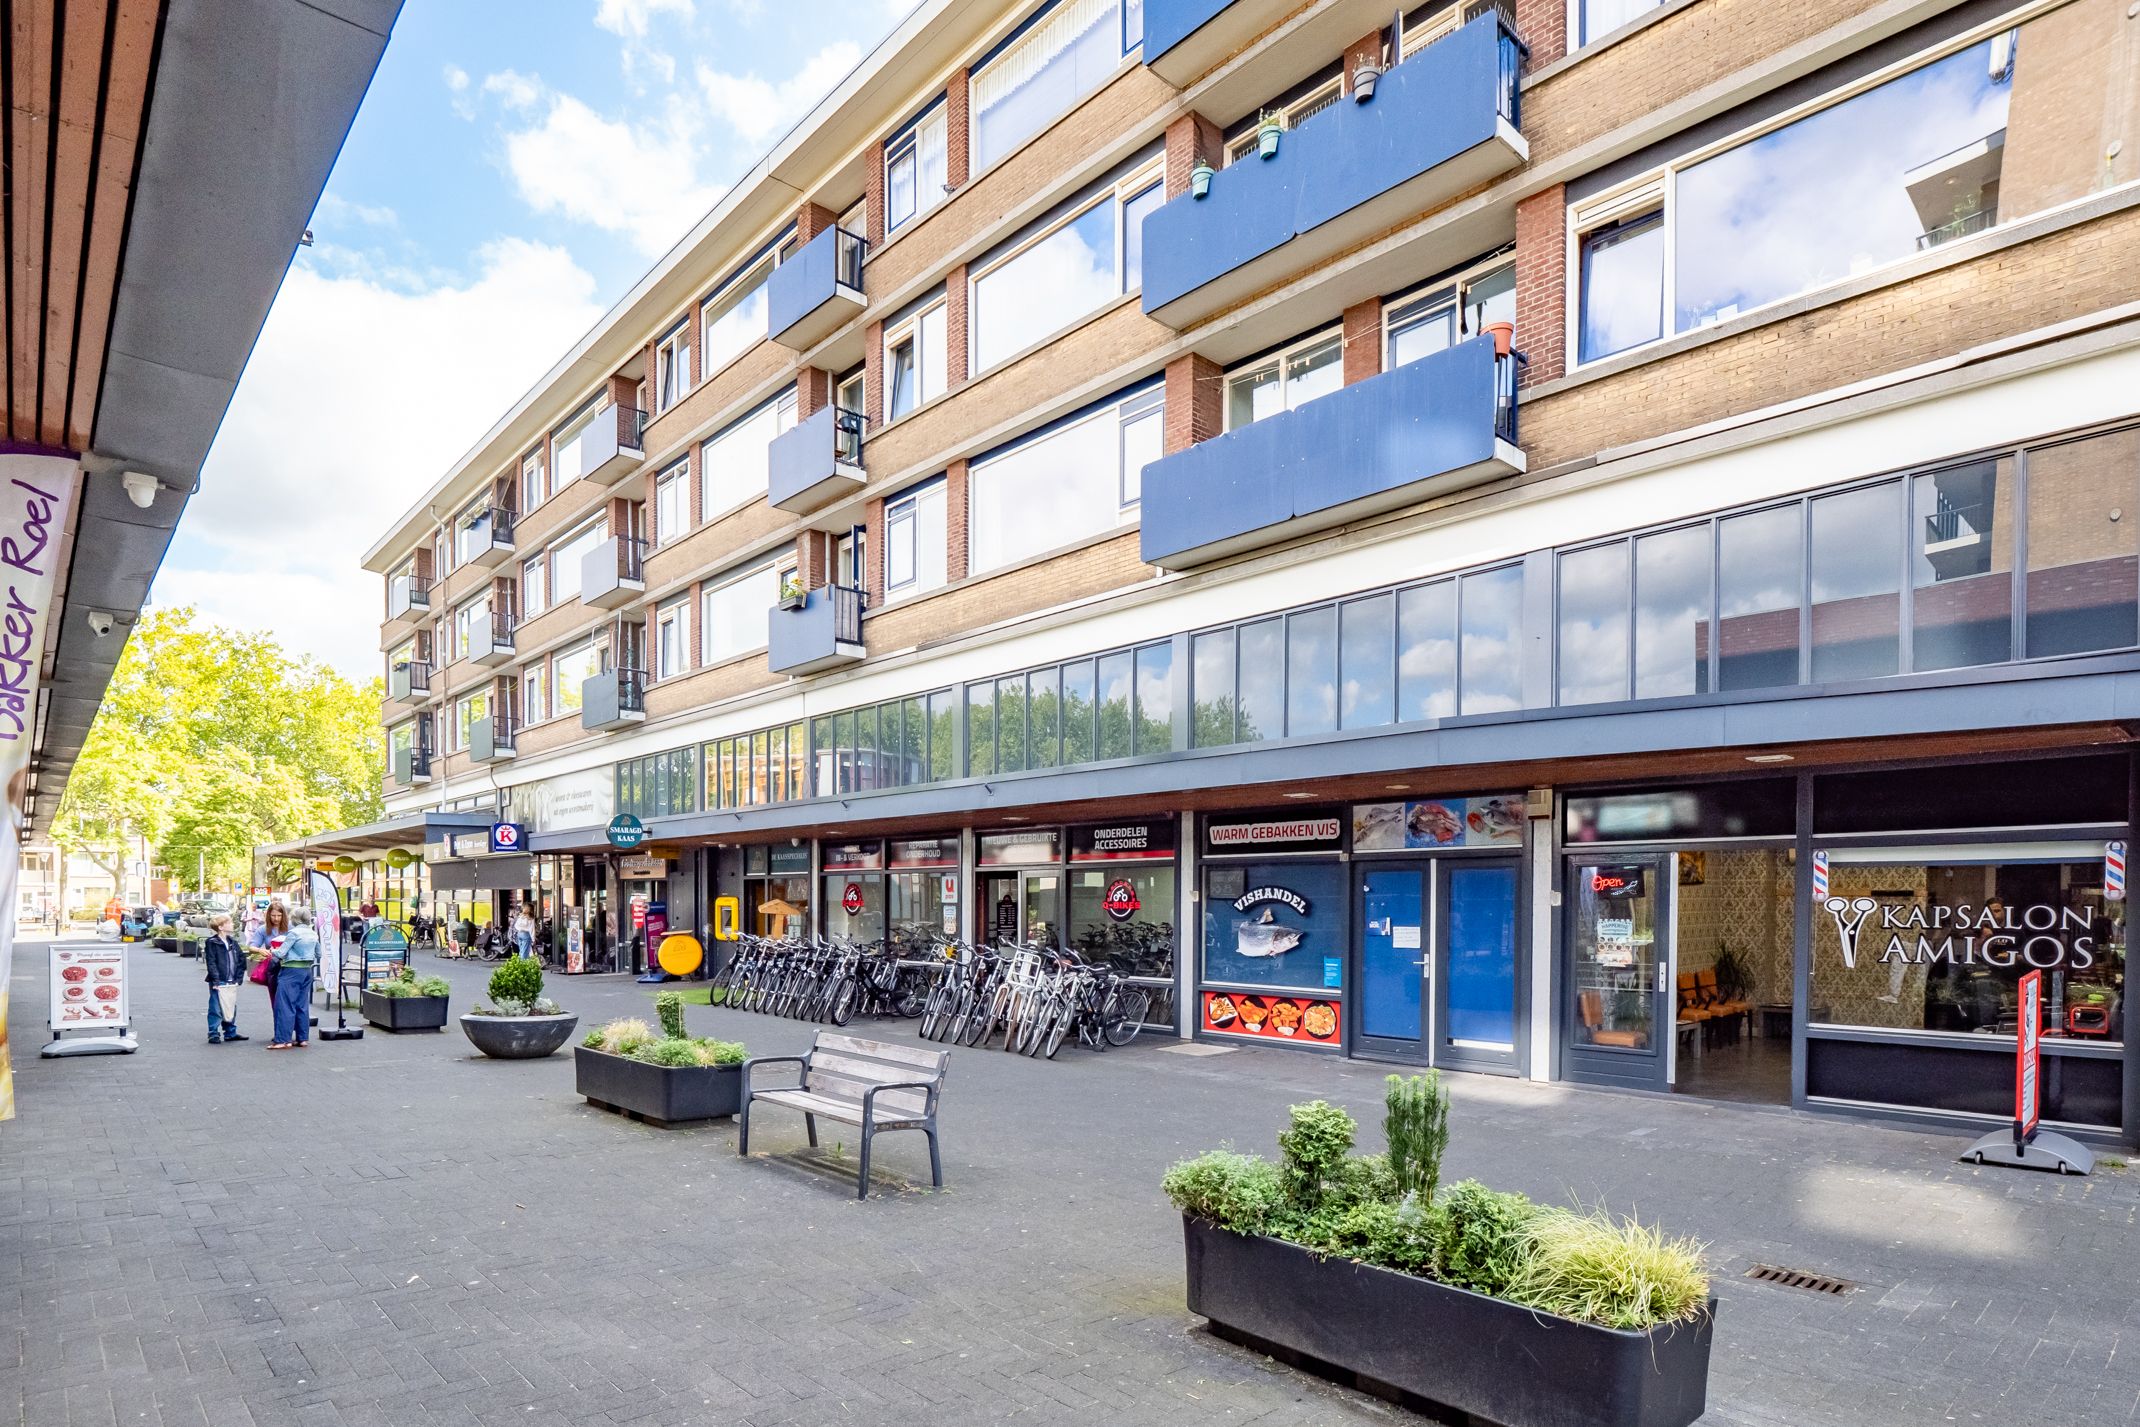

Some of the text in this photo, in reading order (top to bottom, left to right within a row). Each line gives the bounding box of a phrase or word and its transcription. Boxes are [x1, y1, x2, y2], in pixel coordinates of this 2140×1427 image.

[1, 478, 59, 576] Roel
[609, 826, 642, 834] SMARAGD
[1094, 827, 1148, 839] ONDERDELEN
[1212, 822, 1337, 841] WARM GEBAKKEN VIS
[499, 831, 513, 842] K
[1019, 832, 1057, 843] GEBRUIKTE
[1094, 838, 1148, 850] ACCESSOIRES
[906, 849, 941, 858] ONDERHOUD
[1592, 875, 1624, 891] Open
[1102, 901, 1141, 910] Q-BIKES
[1233, 887, 1307, 914] VISHANDEL
[1881, 905, 2093, 930] KAPSALON
[1878, 935, 2093, 968] AMIGOS
